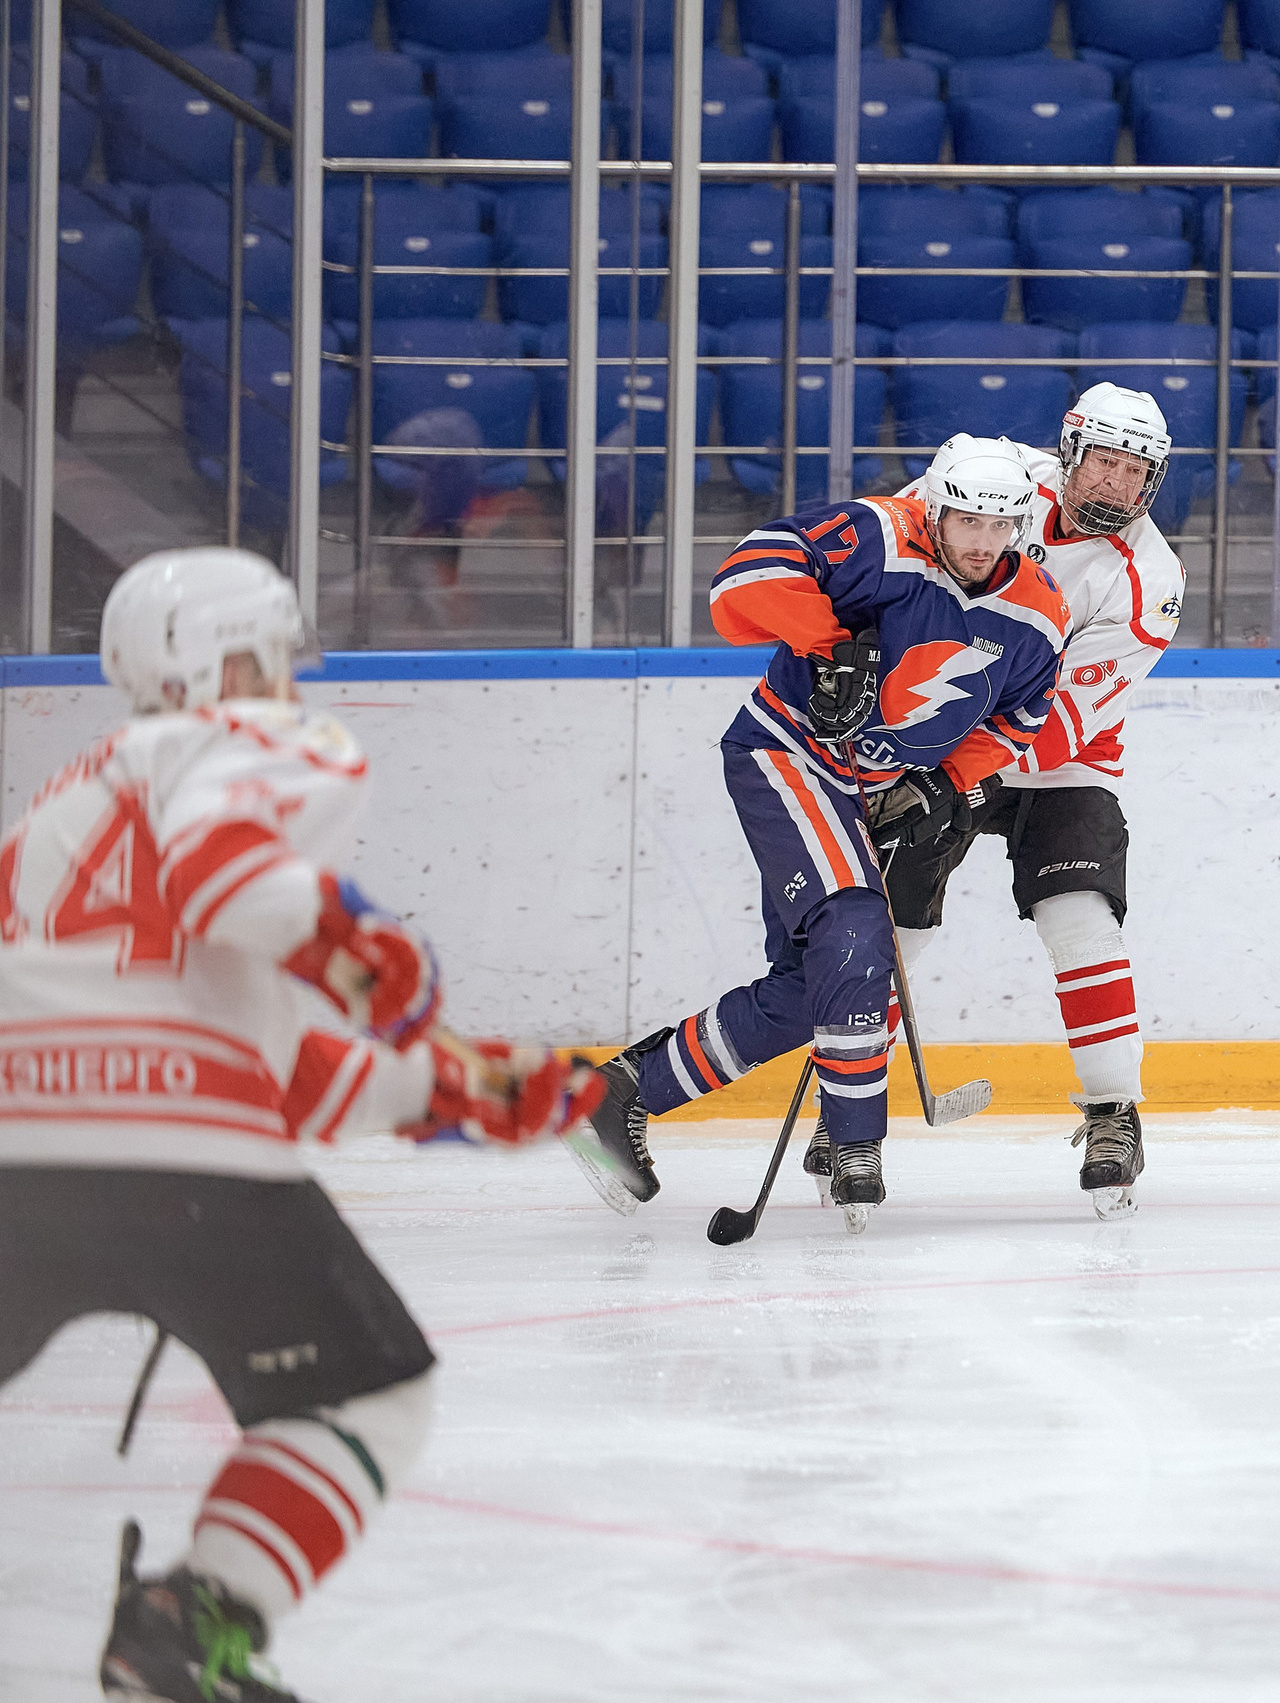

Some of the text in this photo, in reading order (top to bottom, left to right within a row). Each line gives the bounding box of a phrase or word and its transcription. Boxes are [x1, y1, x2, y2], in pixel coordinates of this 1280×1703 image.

[1122, 428, 1154, 441] BAUER
[977, 492, 1009, 501] CCM
[800, 512, 859, 564] 17
[971, 635, 1005, 657] МОЛНИЯ
[1036, 860, 1101, 878] BAUER
